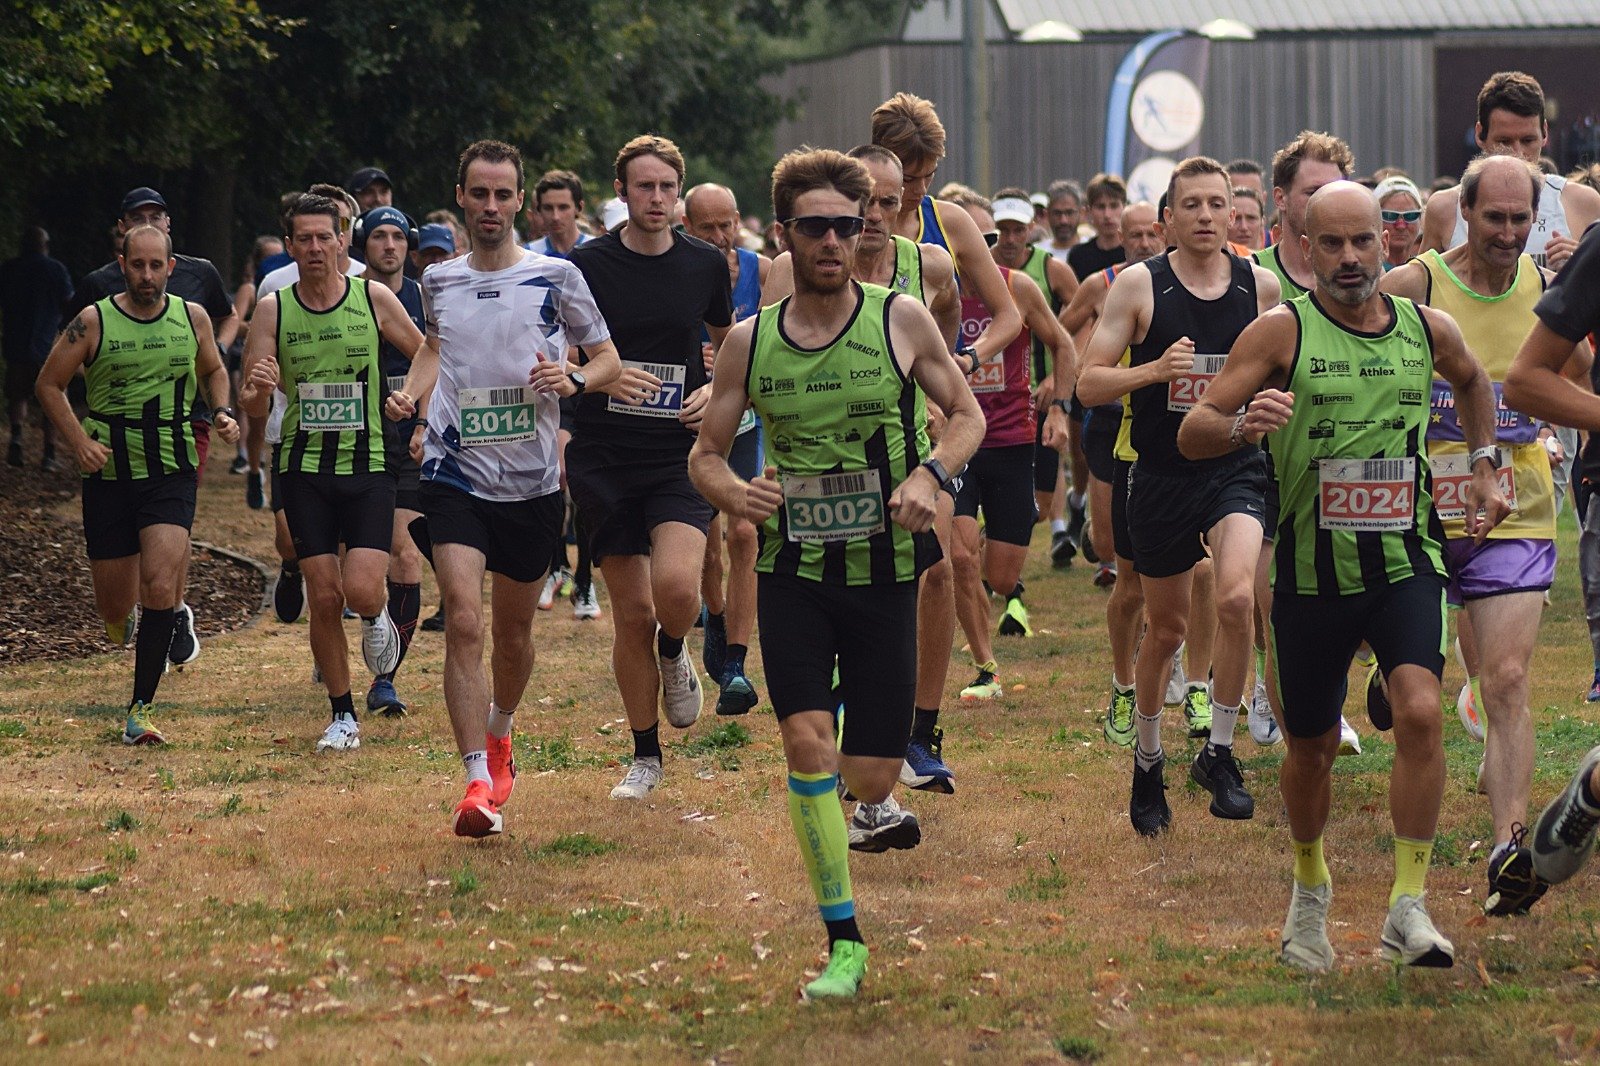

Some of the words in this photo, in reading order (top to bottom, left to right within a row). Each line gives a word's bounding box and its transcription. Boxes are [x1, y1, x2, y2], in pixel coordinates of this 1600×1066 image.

[318, 333, 343, 342] Athlex
[142, 341, 167, 351] Athlex
[845, 339, 881, 359] BIORACER
[1328, 364, 1350, 373] press
[1359, 366, 1396, 378] Athlex
[805, 381, 842, 394] Athlex
[1174, 377, 1210, 400] 20
[1324, 394, 1353, 403] EXPERTS
[304, 402, 357, 421] 3021
[850, 402, 882, 413] FIESIEK
[465, 408, 531, 434] 3014
[1436, 472, 1512, 507] 204
[1326, 486, 1410, 514] 2024
[792, 498, 879, 528] 3002
[1328, 520, 1408, 529] www.krekenlopers.be
